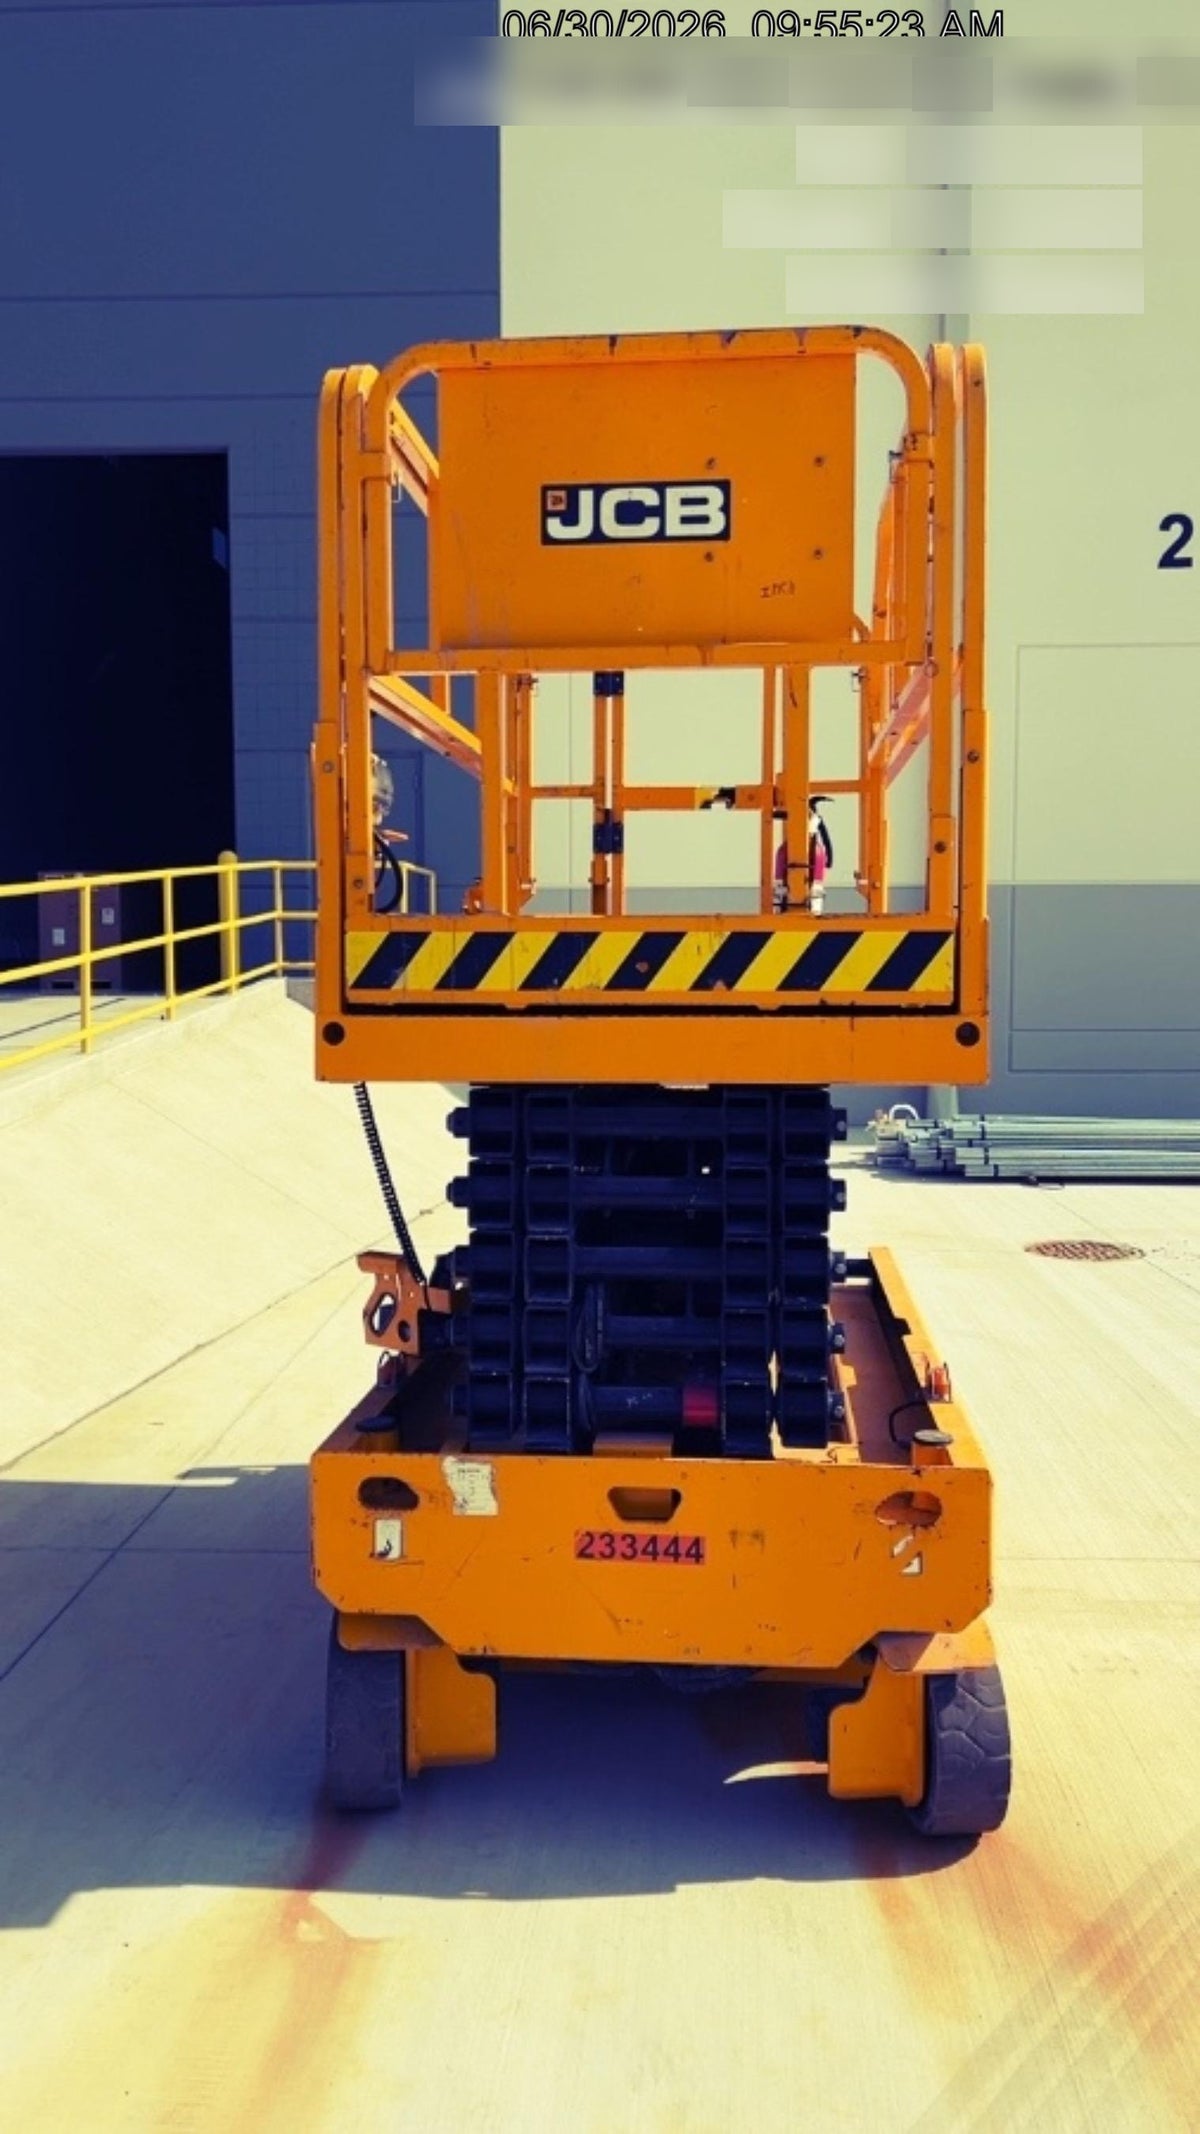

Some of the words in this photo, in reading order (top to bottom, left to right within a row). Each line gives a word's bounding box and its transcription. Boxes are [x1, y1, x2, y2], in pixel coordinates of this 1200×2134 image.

[546, 486, 726, 540] JCB
[1157, 513, 1193, 569] 2
[576, 1531, 704, 1564] 233444
